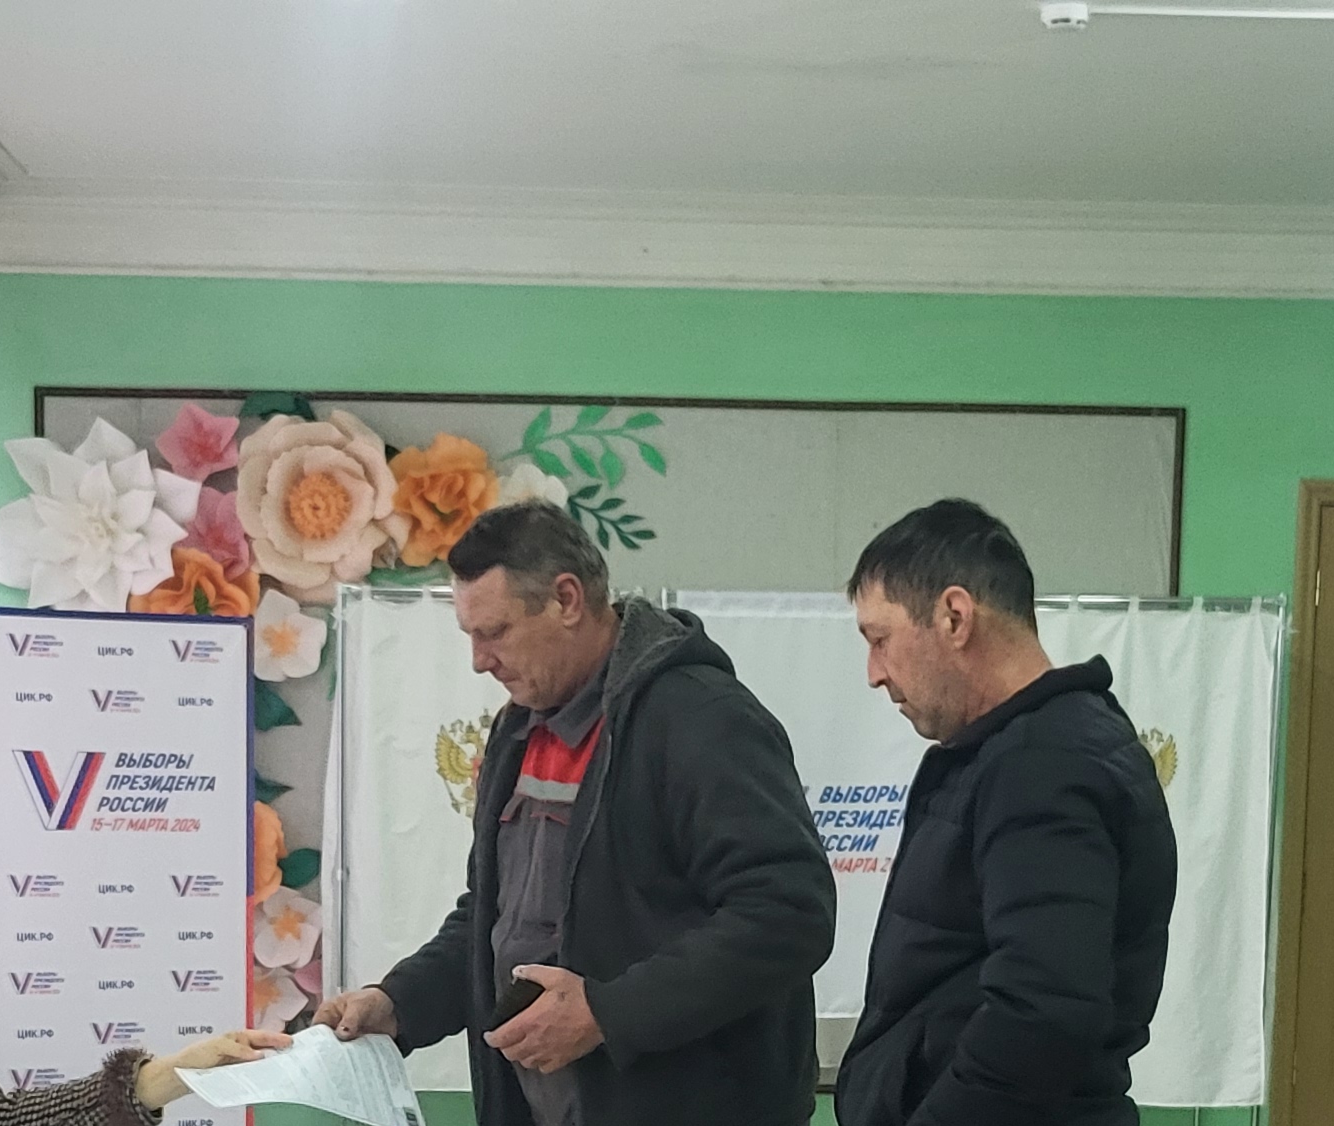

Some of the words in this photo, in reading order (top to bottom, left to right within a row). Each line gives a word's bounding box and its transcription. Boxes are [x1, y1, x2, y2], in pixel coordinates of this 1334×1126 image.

[115, 752, 194, 769] ВЫБОРЫ
[106, 775, 216, 793] ПРЕЗИДЕНТА
[819, 784, 908, 803] ВЫБОРЫ
[97, 796, 169, 813] РОССИИ
[126, 818, 168, 832] МАРТА
[170, 818, 201, 832] 2024
[832, 857, 878, 873] МАРТА
